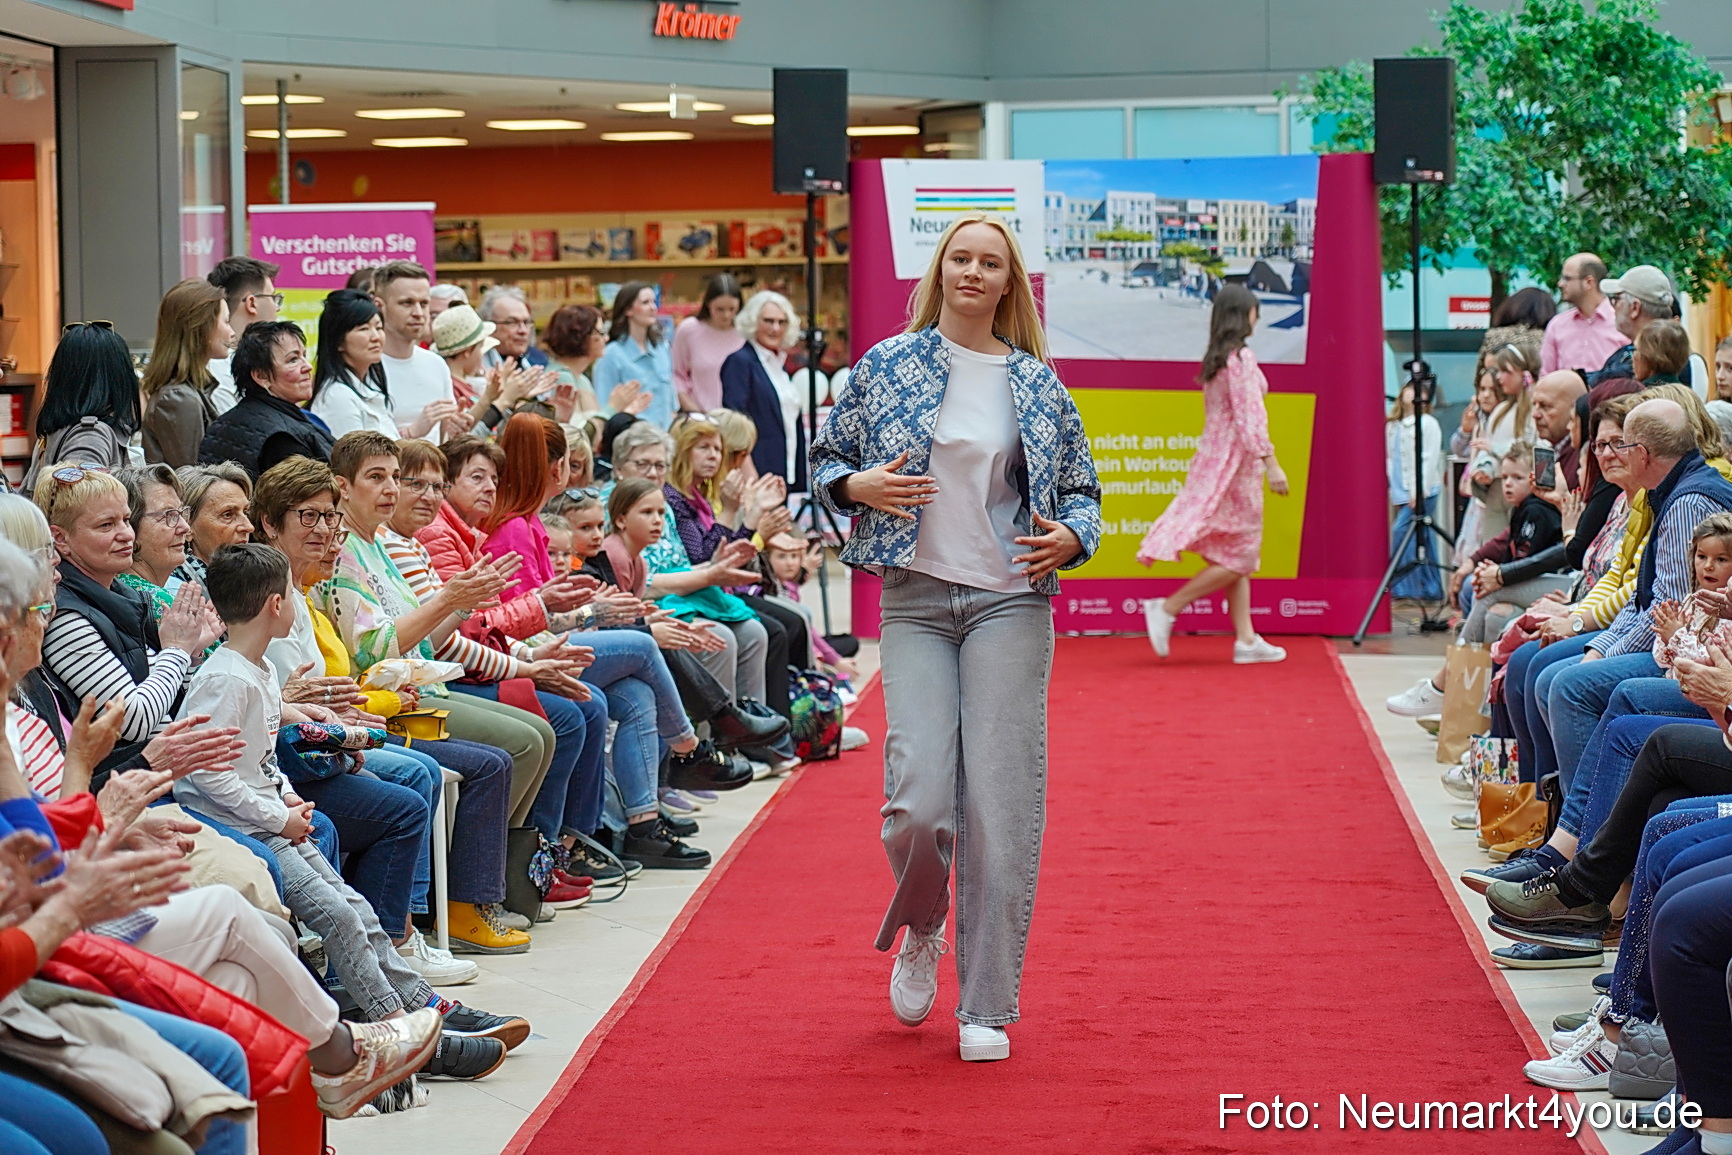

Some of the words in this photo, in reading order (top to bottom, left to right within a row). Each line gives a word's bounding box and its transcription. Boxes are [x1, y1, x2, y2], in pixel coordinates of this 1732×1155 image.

[655, 3, 741, 40] Krömer
[261, 234, 384, 254] Verschenken
[385, 233, 417, 252] Sie
[302, 255, 417, 275] Gutschei!
[1094, 433, 1138, 450] nicht
[1142, 436, 1165, 450] an
[1124, 455, 1191, 473] Workou
[1101, 478, 1184, 495] umurlaub
